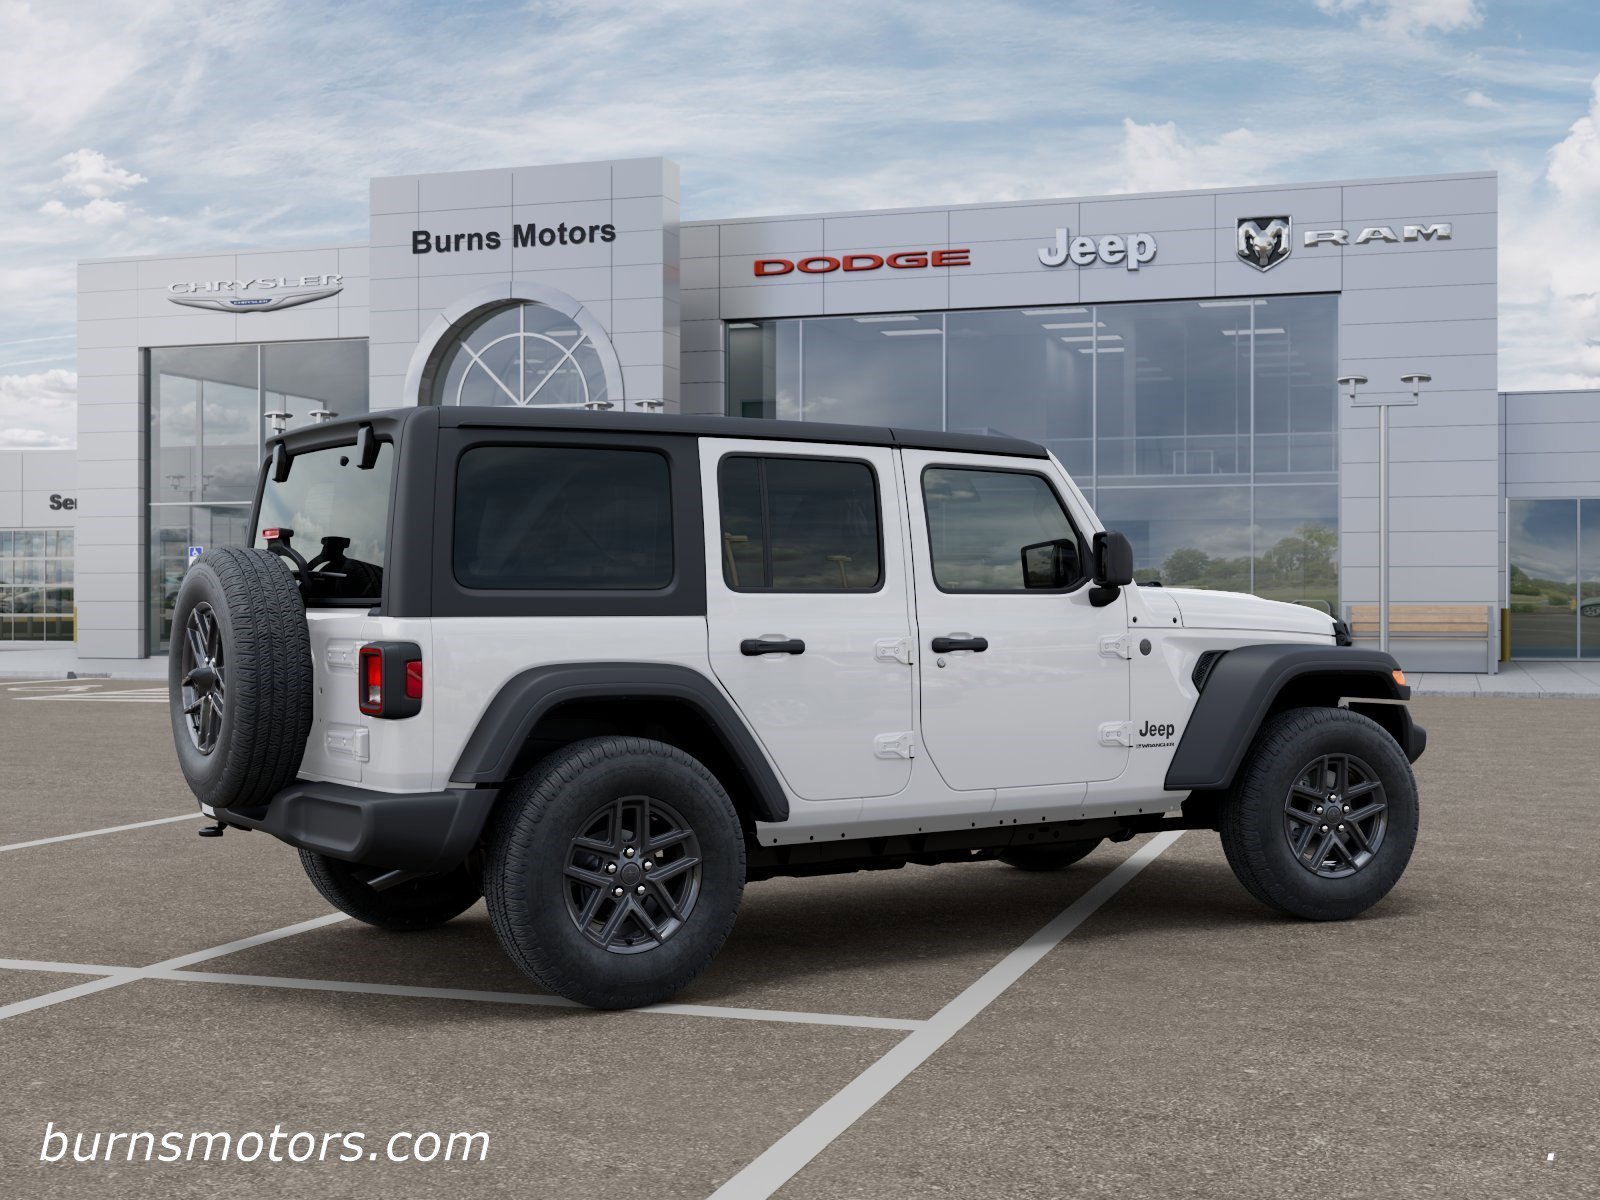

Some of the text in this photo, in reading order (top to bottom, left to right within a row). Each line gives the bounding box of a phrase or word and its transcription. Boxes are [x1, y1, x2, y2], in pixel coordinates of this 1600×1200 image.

[412, 222, 616, 254] Burns Motors
[1304, 223, 1452, 247] RAM
[1038, 227, 1157, 272] Jeep
[754, 249, 971, 276] DODGE
[168, 273, 343, 293] CHRYSLER
[1139, 720, 1175, 739] Jeep
